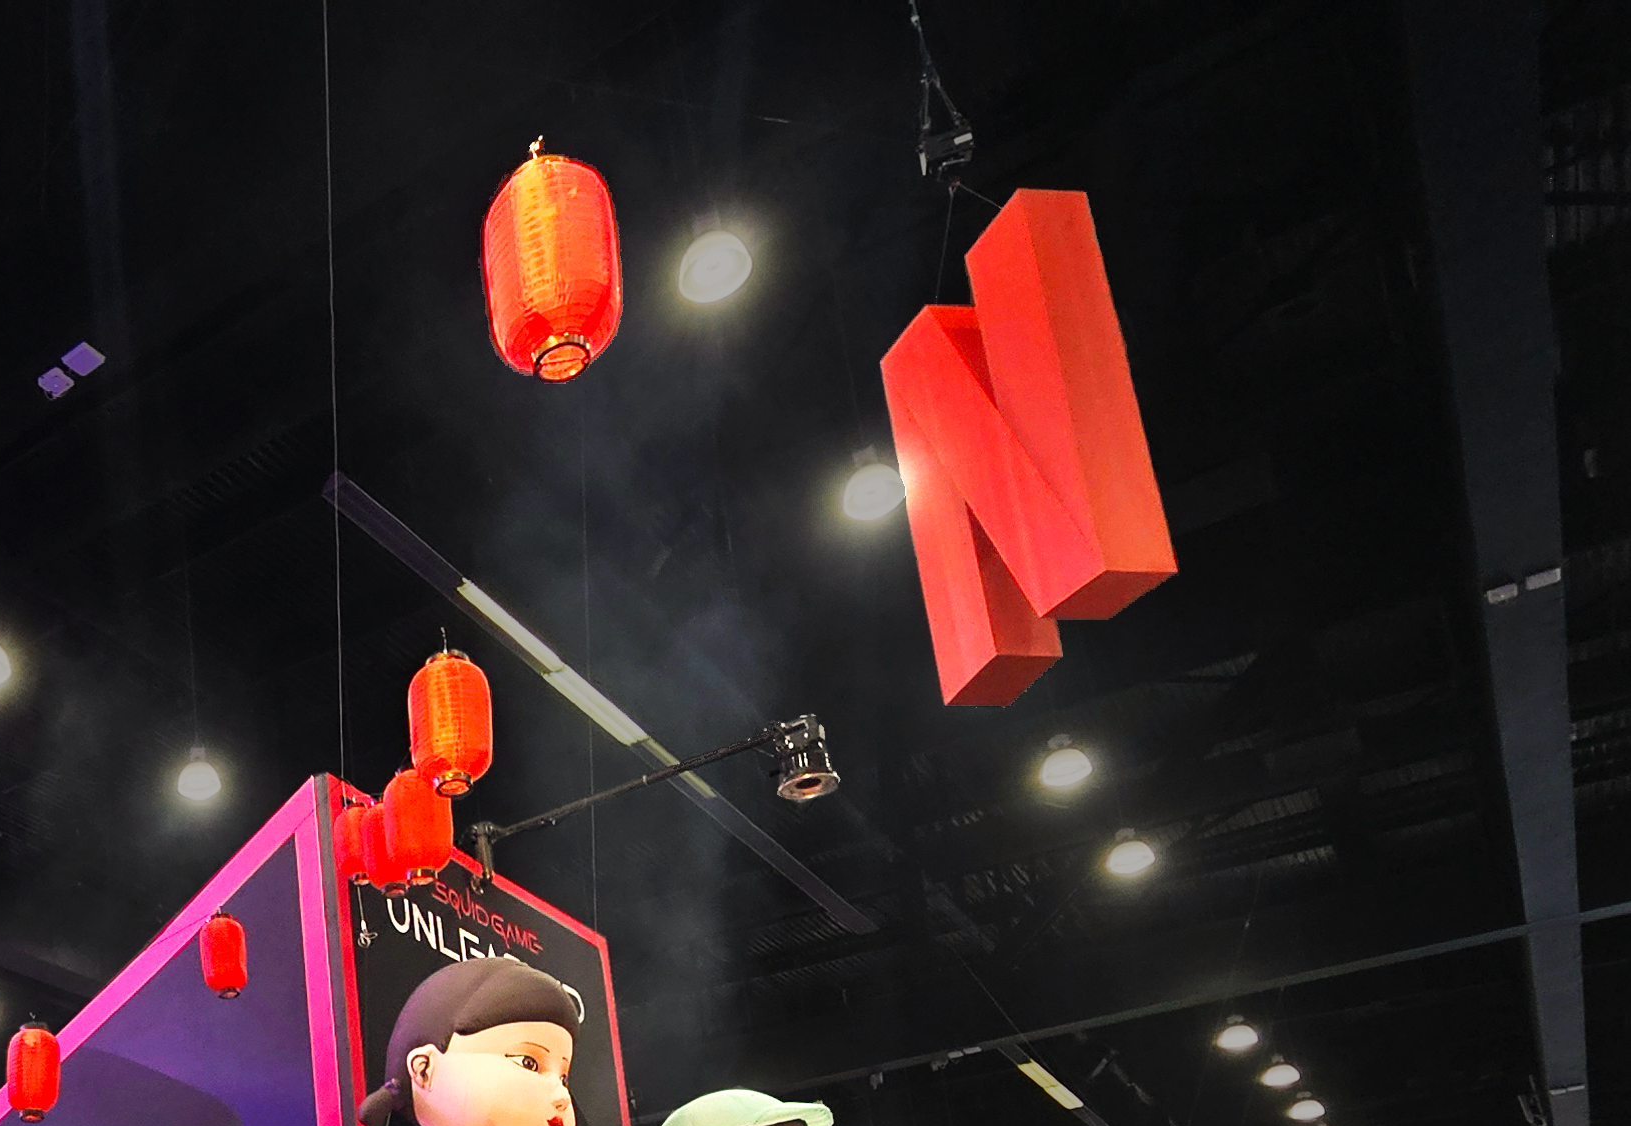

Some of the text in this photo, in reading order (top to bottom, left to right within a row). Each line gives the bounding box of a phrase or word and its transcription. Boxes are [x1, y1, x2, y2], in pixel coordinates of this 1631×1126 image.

[881, 188, 1179, 707] N
[431, 881, 544, 955] SQUID GAME
